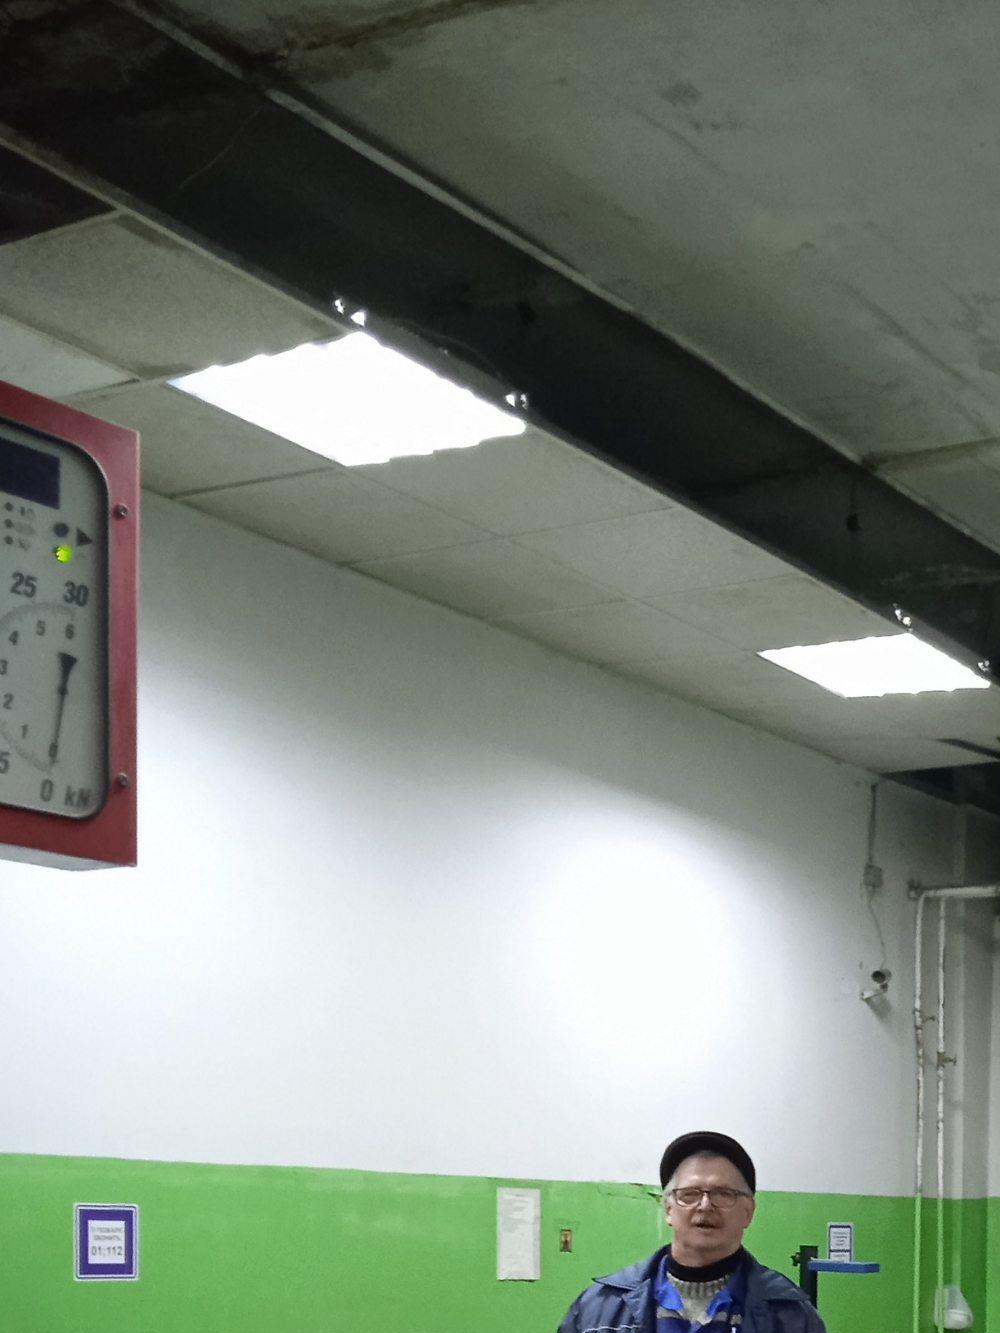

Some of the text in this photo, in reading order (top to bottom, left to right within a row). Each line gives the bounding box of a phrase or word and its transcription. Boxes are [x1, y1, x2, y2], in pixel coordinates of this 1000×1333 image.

[10, 571, 37, 598] 25
[63, 580, 89, 607] 30
[36, 620, 46, 636] 5
[65, 624, 75, 640] 6
[9, 630, 19, 646] 4
[3, 693, 14, 710] 2
[21, 723, 28, 739] 1
[40, 779, 54, 802] 0
